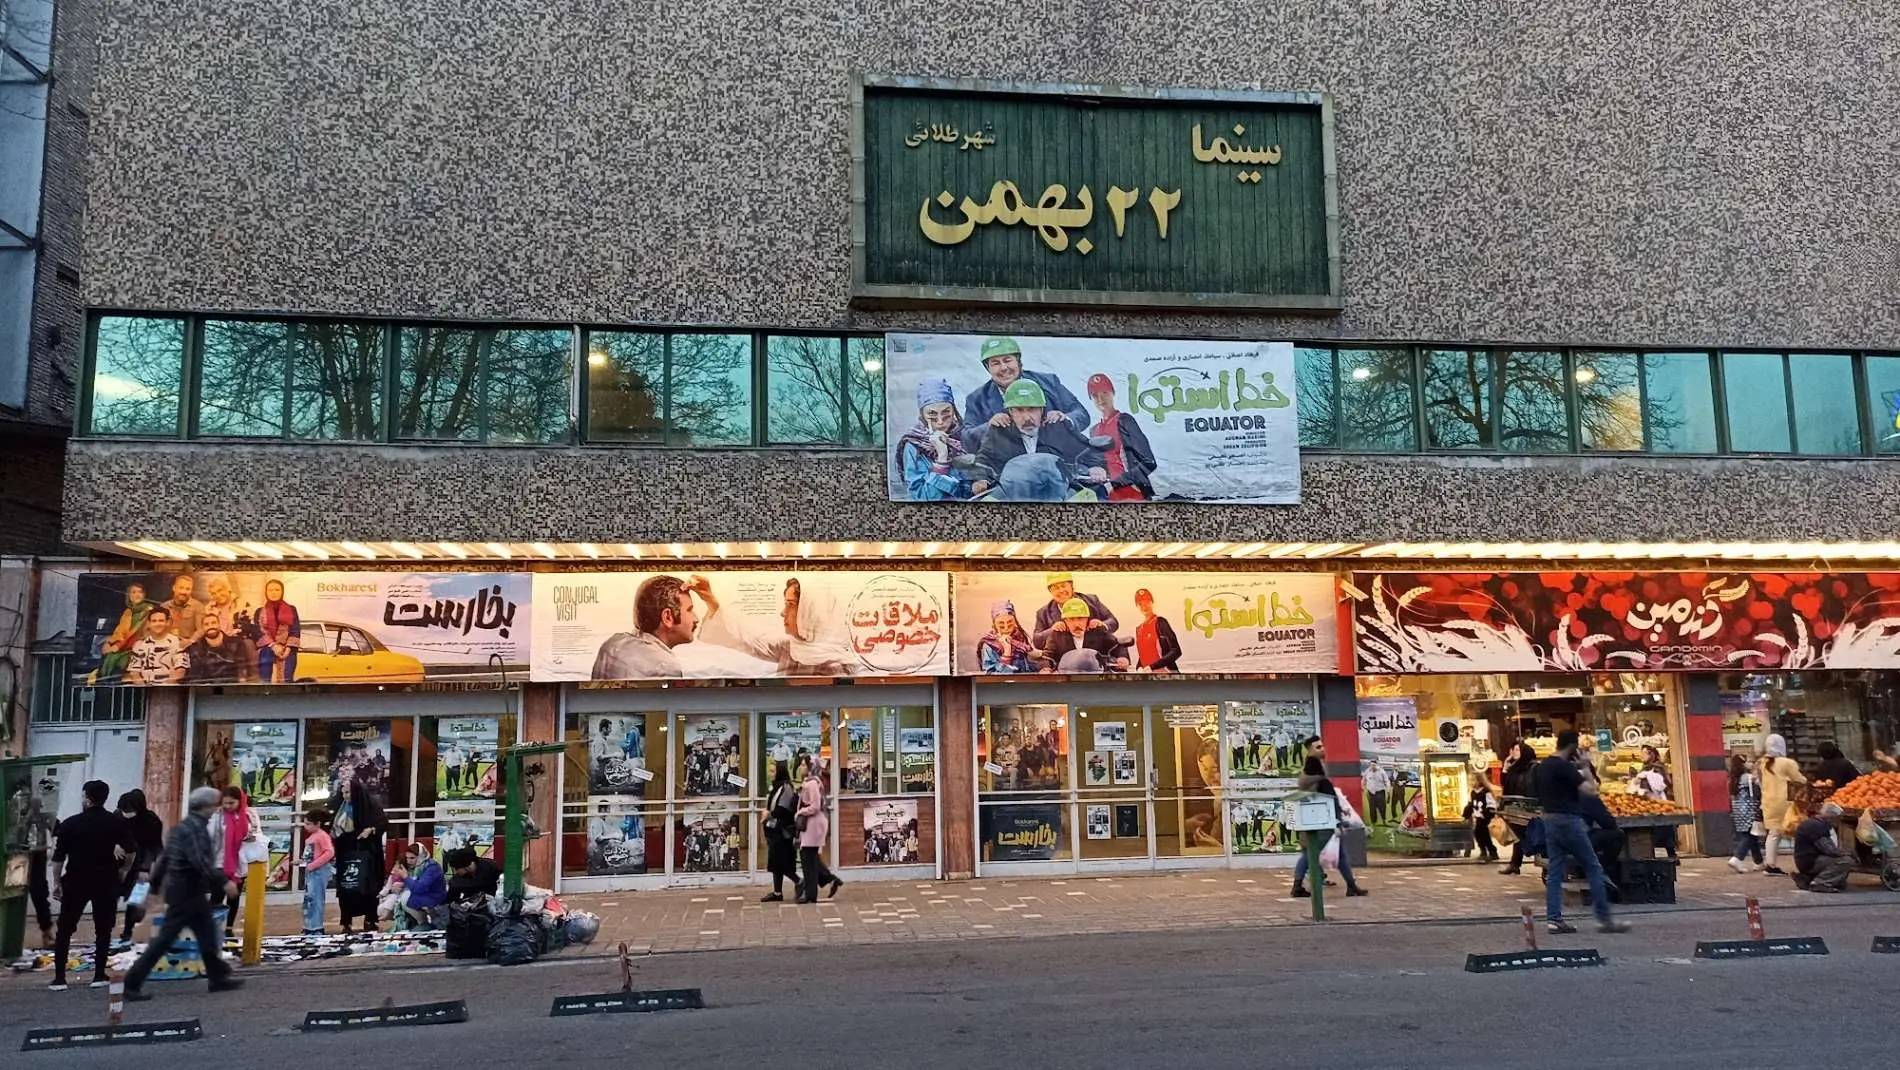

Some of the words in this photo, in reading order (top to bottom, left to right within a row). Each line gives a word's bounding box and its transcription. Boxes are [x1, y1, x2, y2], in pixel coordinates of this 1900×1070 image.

[960, 121, 996, 150] شهر
[1190, 123, 1282, 183] سینما
[919, 179, 1094, 256] بهمن
[1106, 186, 1181, 240] ۲۲
[1127, 369, 1230, 423] استوا
[1233, 367, 1290, 412] خط
[1185, 415, 1266, 432] EQUATOR
[317, 582, 377, 592] Bokharest
[553, 586, 599, 604] CONJUGAL
[383, 584, 517, 639] بخارست
[556, 603, 577, 621] VISIT
[852, 600, 939, 627] ملاقات
[1184, 594, 1266, 639] استوا
[1269, 591, 1315, 628] خط
[853, 626, 942, 654] خصوصی
[1258, 629, 1315, 642] EQUATOR
[1395, 714, 1415, 729] خط
[998, 823, 1057, 849] بخارست
